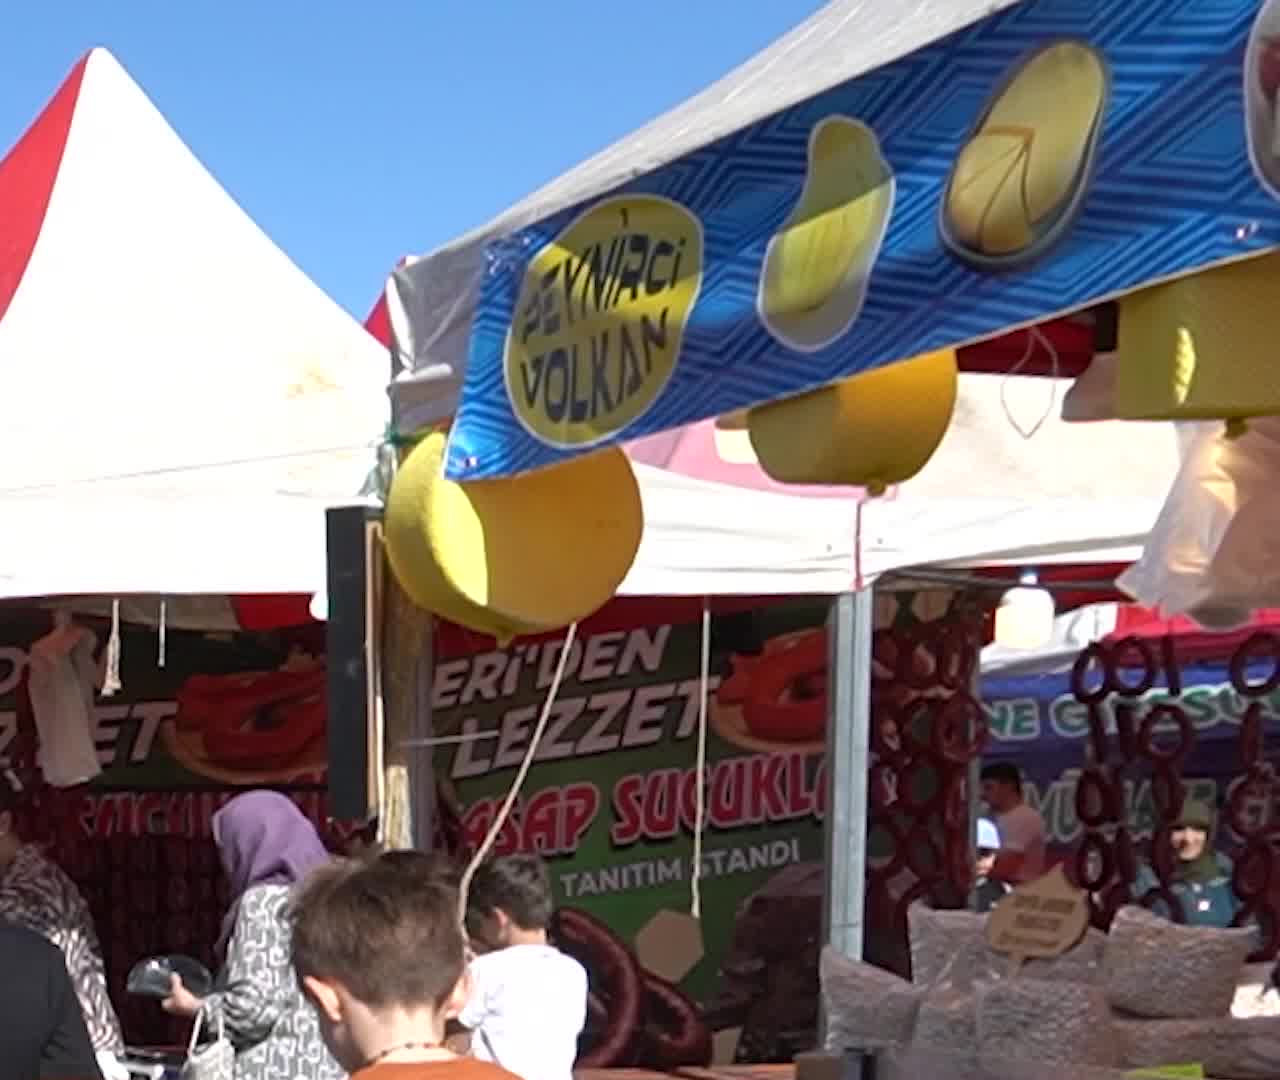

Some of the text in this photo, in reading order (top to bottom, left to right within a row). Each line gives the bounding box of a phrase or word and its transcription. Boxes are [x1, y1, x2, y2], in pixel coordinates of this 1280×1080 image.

[519, 306, 669, 424] VOLKAN
[451, 674, 722, 779] LEZZET
[558, 838, 800, 898] TANITIM STANDI
